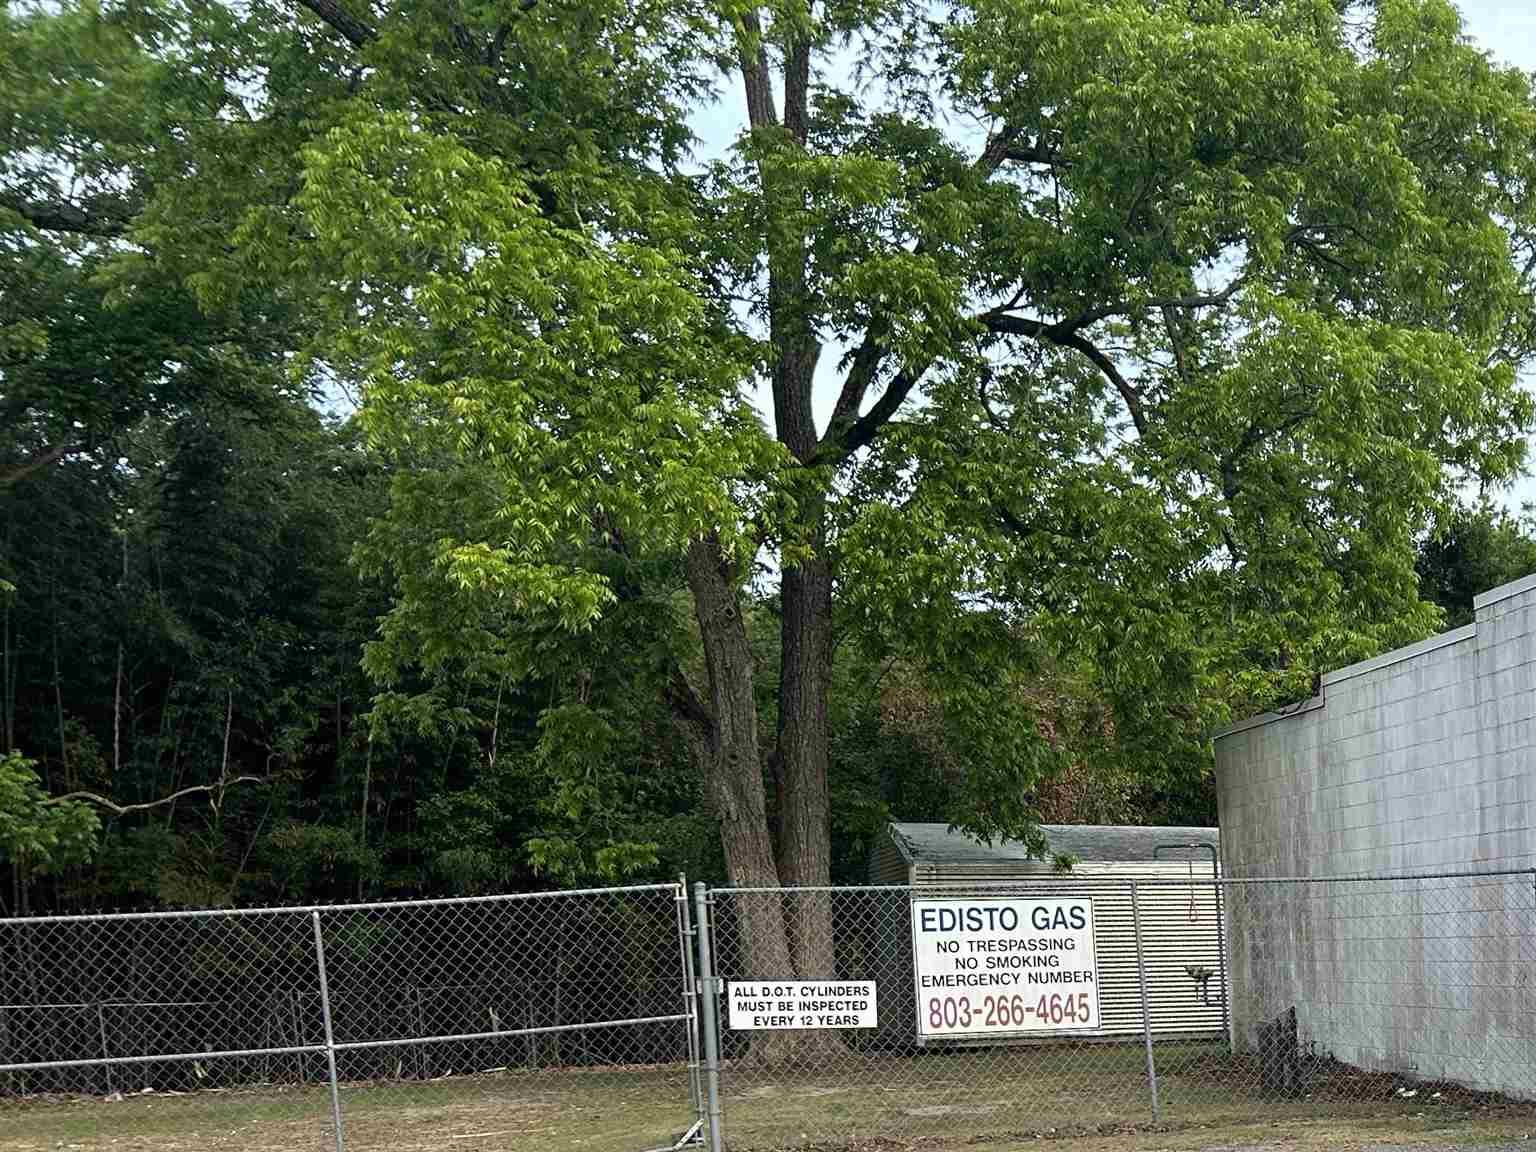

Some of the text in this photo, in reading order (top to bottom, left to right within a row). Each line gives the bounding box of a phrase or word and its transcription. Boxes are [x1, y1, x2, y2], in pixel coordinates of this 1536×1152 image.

[921, 906, 1086, 932] EDISTO GAS
[936, 938, 1076, 953] NO TRESPASSING
[955, 955, 1060, 969] NO SMOKING
[921, 971, 1093, 987] EMERGENCY NUMBER
[734, 986, 870, 997] ALL D.O.T. CYLINDERS
[737, 1000, 868, 1011] MUST BE INSPECTED
[929, 993, 1090, 1029] 803-266-4645
[754, 1015, 860, 1026] EVERY 12 YEARS
